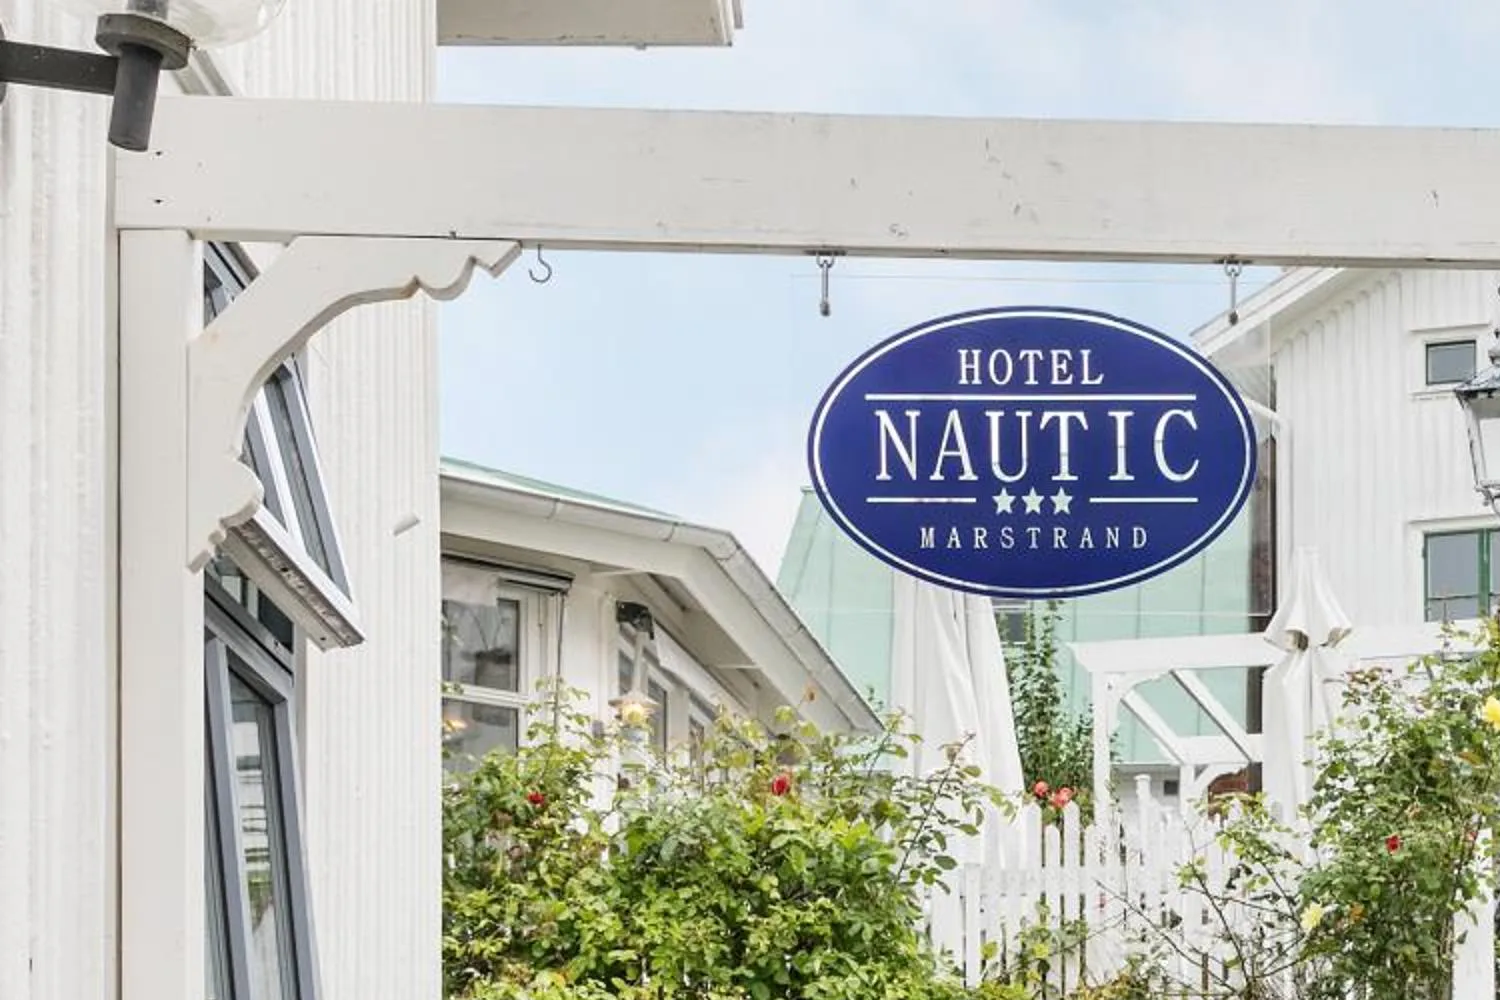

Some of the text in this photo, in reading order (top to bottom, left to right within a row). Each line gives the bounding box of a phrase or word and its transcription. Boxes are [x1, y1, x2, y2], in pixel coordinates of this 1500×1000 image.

[957, 348, 1105, 386] HOTEL
[873, 408, 1200, 483] NAUTIC
[919, 526, 1148, 549] MARSTRAND
